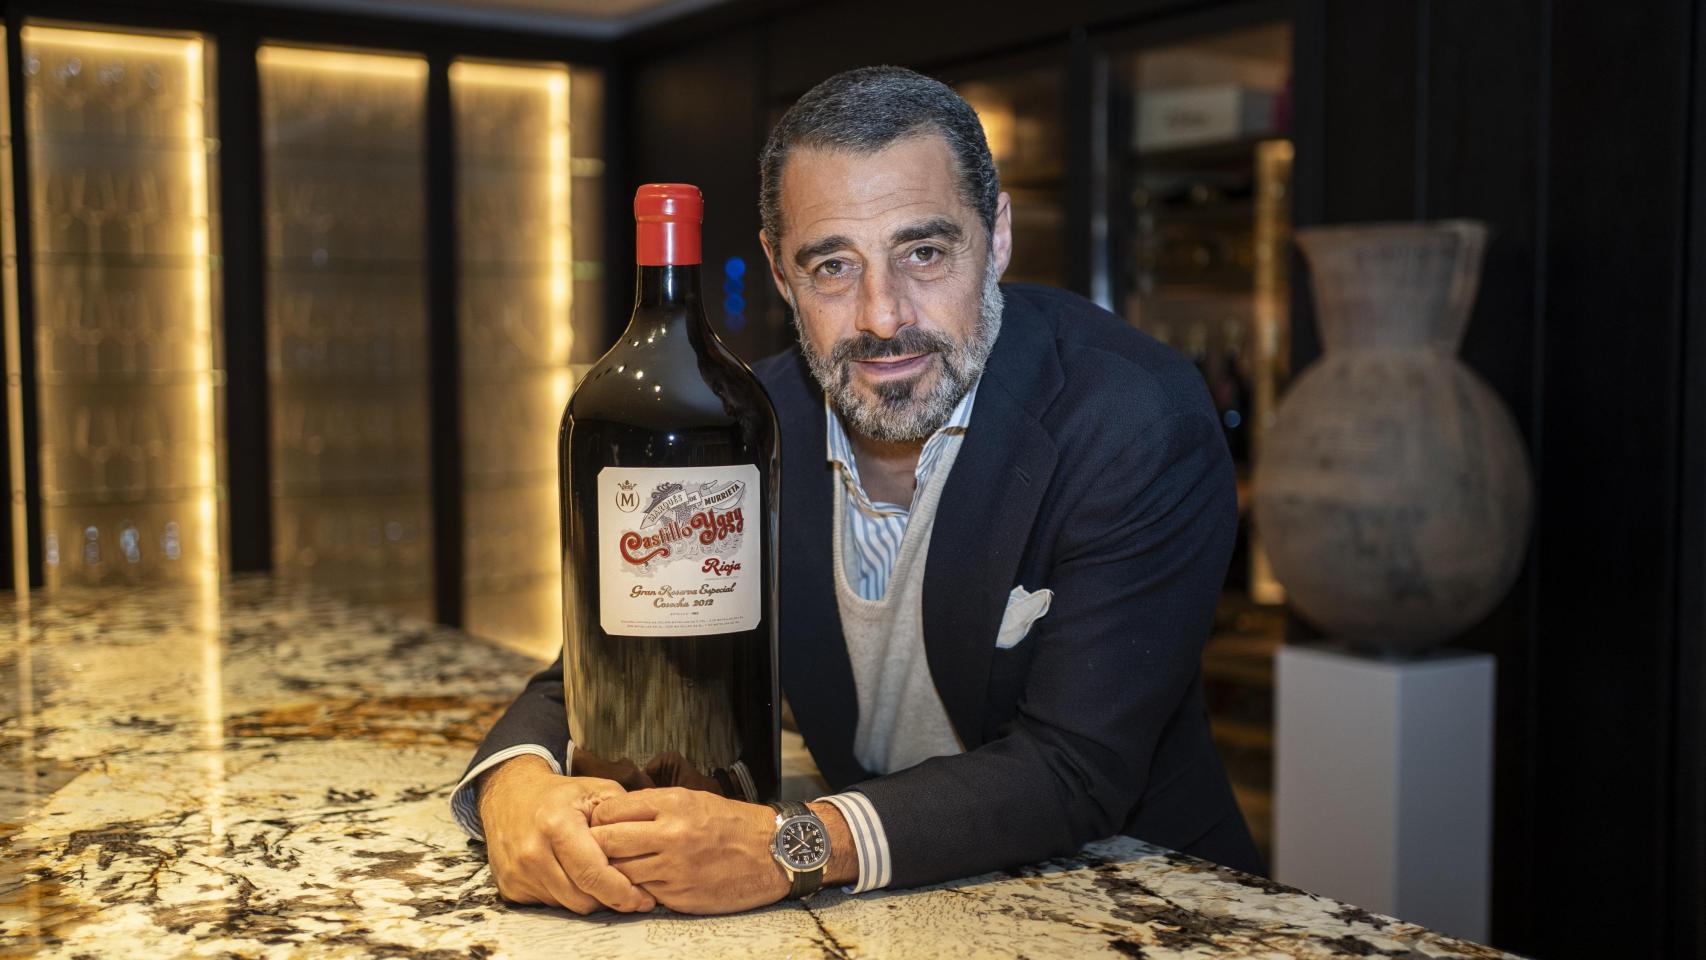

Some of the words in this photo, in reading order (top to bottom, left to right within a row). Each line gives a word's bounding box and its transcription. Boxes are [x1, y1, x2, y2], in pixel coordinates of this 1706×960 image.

[621, 494, 634, 506] M
[704, 483, 740, 506] MURRIETA
[619, 521, 693, 566] Castillo
[701, 557, 741, 576] Rioja
[629, 585, 656, 598] Gran
[658, 584, 698, 598] Reserva
[699, 582, 737, 597] Especial
[653, 597, 690, 608] Cosecha
[692, 598, 714, 607] 2012
